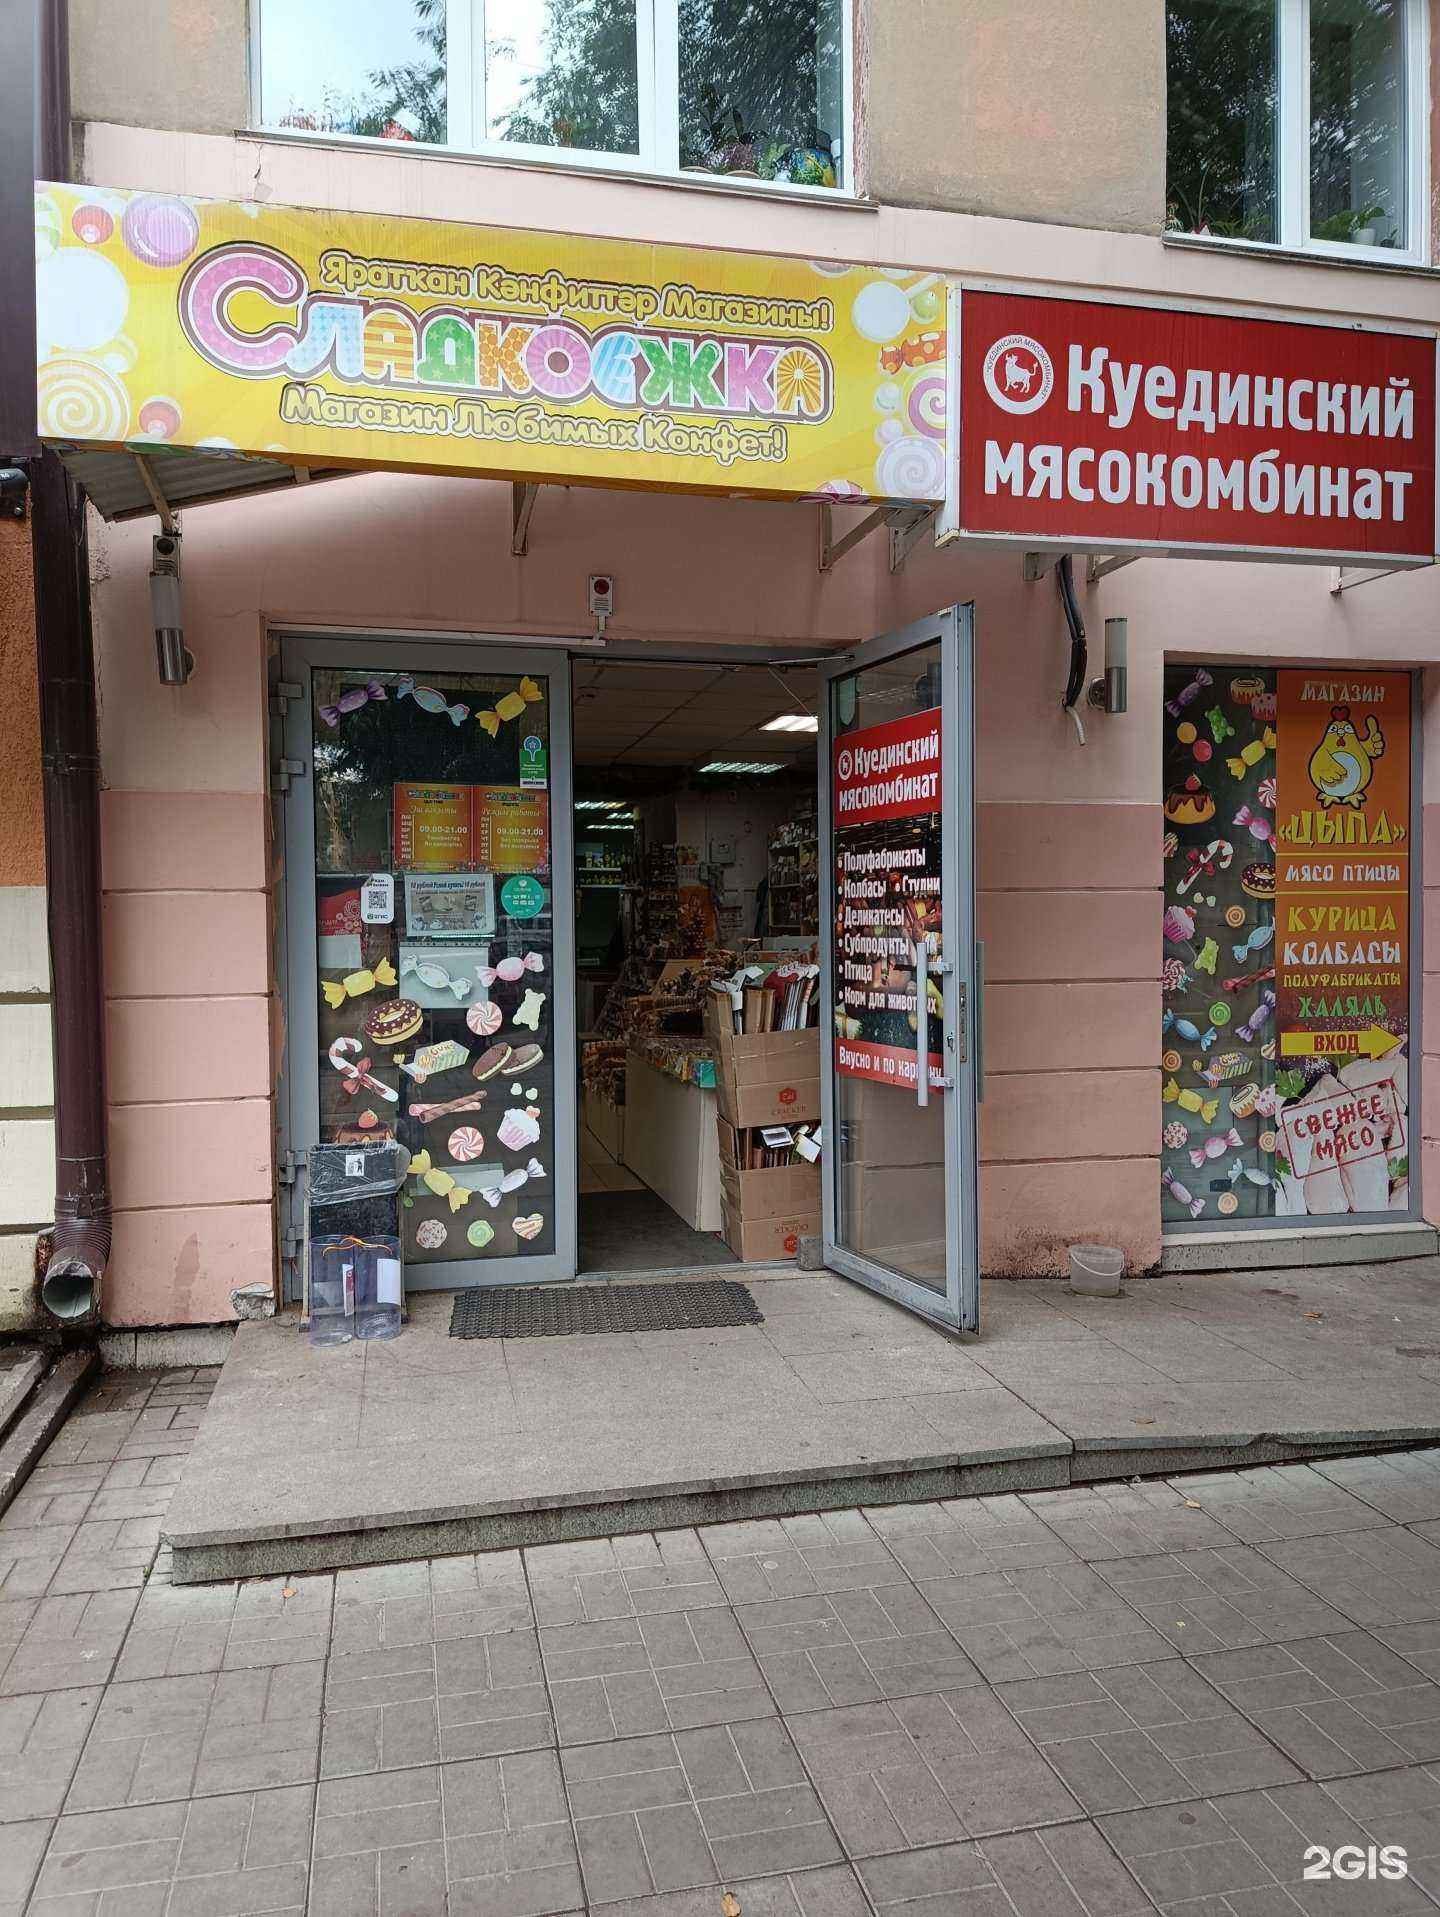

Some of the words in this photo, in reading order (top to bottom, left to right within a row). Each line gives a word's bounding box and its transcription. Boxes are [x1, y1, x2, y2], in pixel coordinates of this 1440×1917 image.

[322, 252, 470, 298] Яраткан
[477, 267, 658, 320] Кәнфиттәр
[662, 289, 832, 330] Магазины!
[1066, 343, 1414, 439] Куединский
[284, 386, 449, 432] Магазин
[451, 401, 638, 447] Любимых
[643, 415, 786, 463] Конфет!
[984, 439, 1414, 522] мясокомбинат
[1300, 681, 1386, 702] МАГАЗИН
[854, 729, 939, 778] Куединский
[839, 772, 939, 812] мясокомбинат
[1278, 808, 1406, 848] «ЦЫПА»
[844, 848, 926, 873] Полуфабрикаты
[1285, 864, 1334, 883] МЯСО
[1342, 863, 1400, 883] ПТИЦЫ
[844, 878, 887, 898] Колбасы
[844, 905, 905, 929] Деликатесы
[1287, 904, 1398, 933] КУРИЦА
[844, 933, 909, 958] Субпродукты
[1283, 940, 1401, 965] КОЛБАСЫ
[844, 960, 873, 984] Птица
[1283, 971, 1401, 987] ПОЛУФАБРИКАТЫ
[844, 986, 866, 1008] Корм
[868, 991, 886, 1010] для
[1298, 994, 1388, 1018] ХАЛЯЛЬ
[1313, 1034, 1359, 1054] ВХОД
[839, 1045, 871, 1069] Вкусно
[874, 1055, 880, 1072] и
[883, 1057, 895, 1074] по
[1293, 1093, 1385, 1139] СВЕЖЕЕ
[1315, 1125, 1375, 1160] МЯСО
